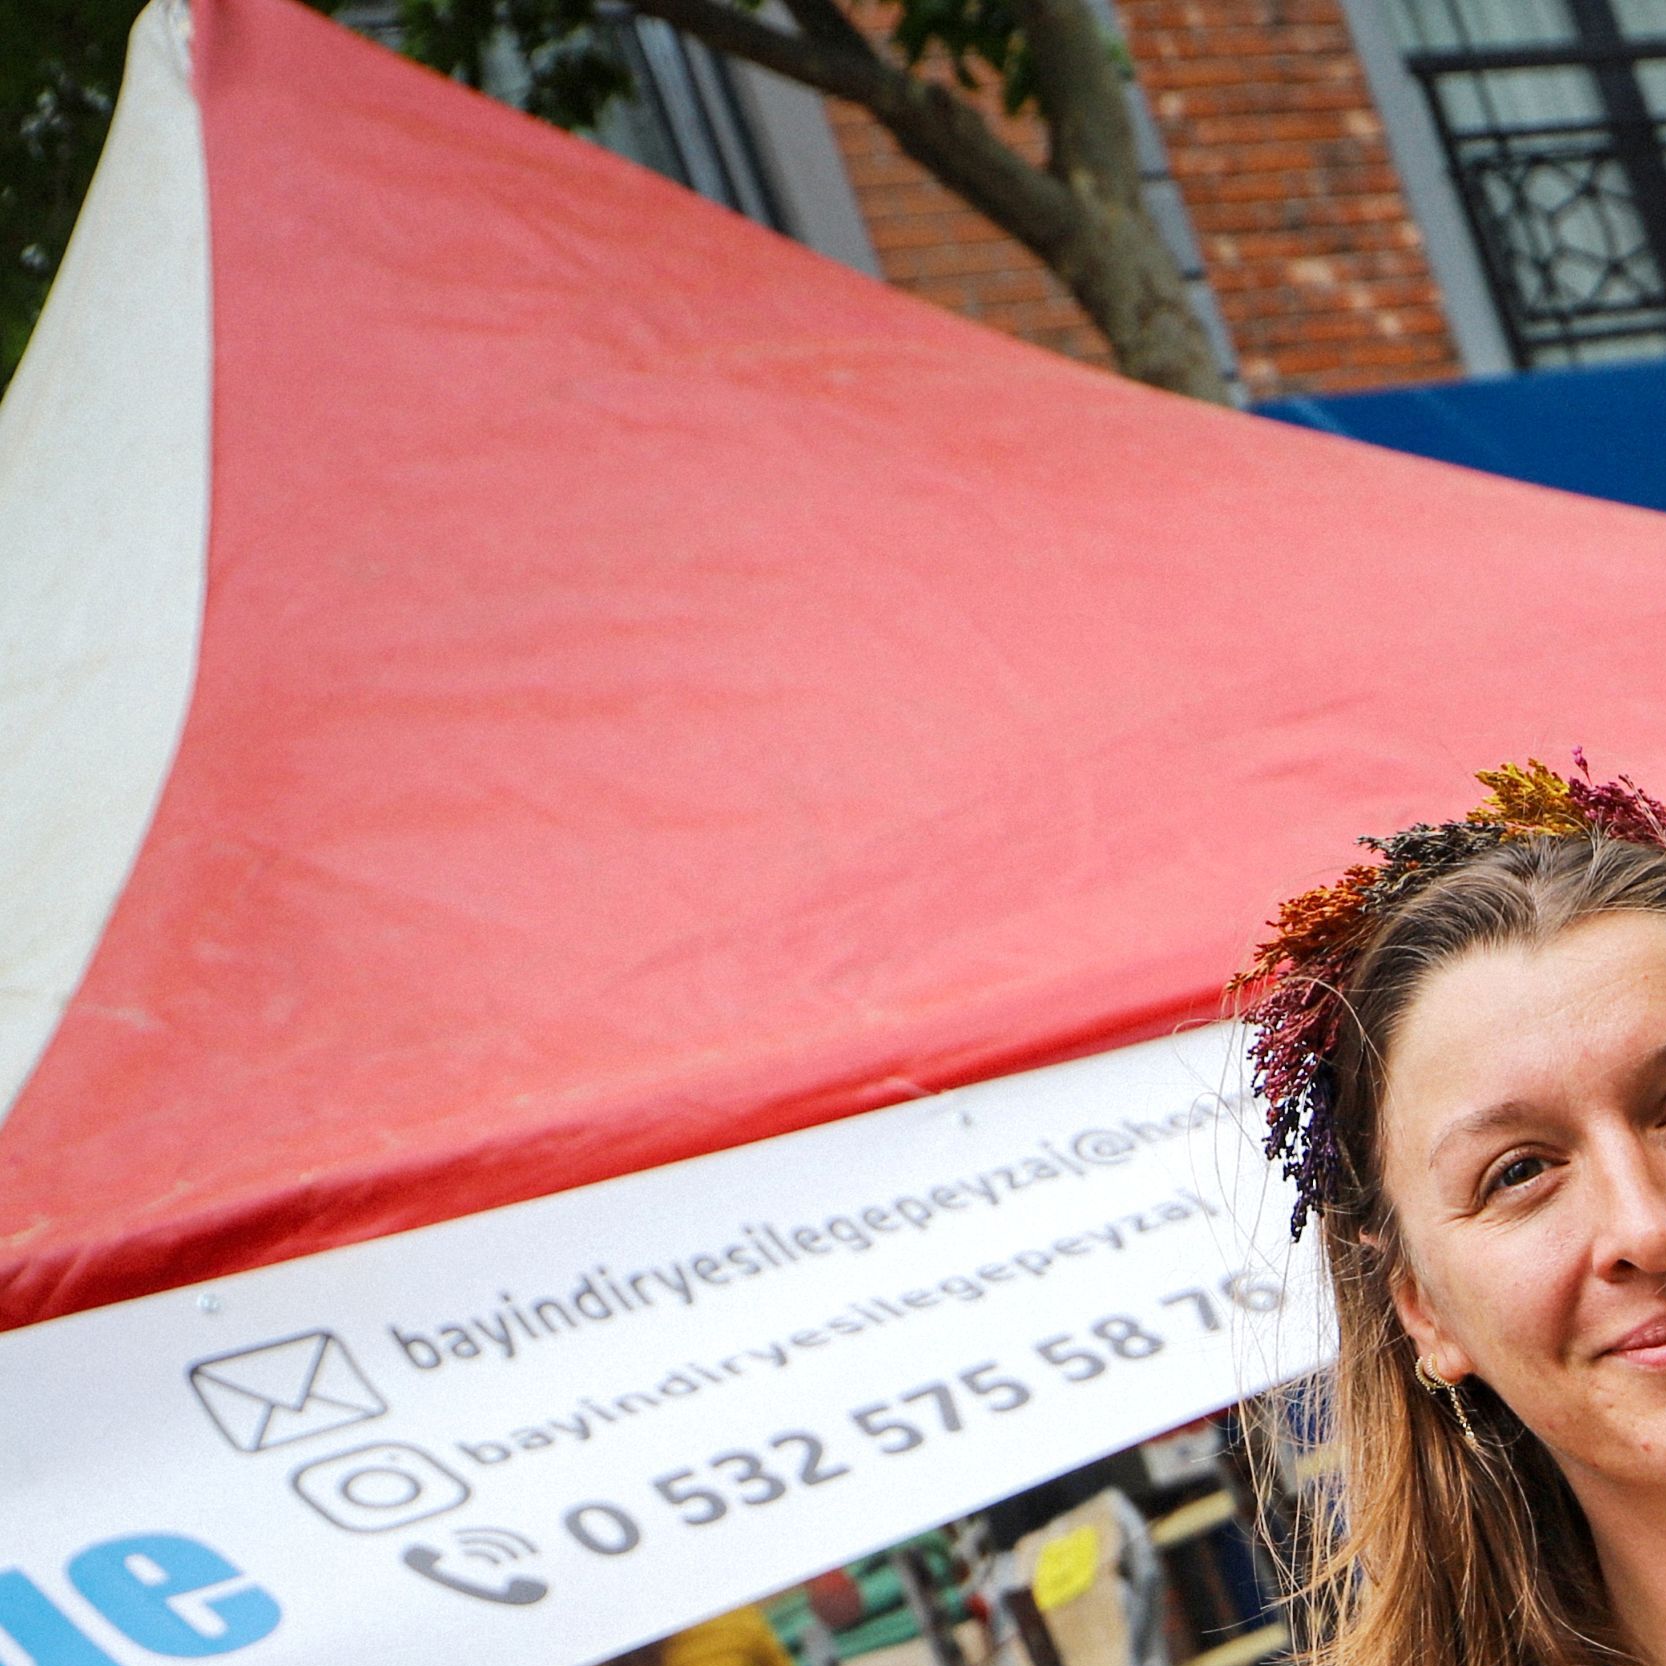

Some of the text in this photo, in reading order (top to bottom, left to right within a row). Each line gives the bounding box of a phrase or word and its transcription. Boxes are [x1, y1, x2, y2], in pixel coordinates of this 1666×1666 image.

[563, 1268, 1286, 1557] 0 532 575 58 76
